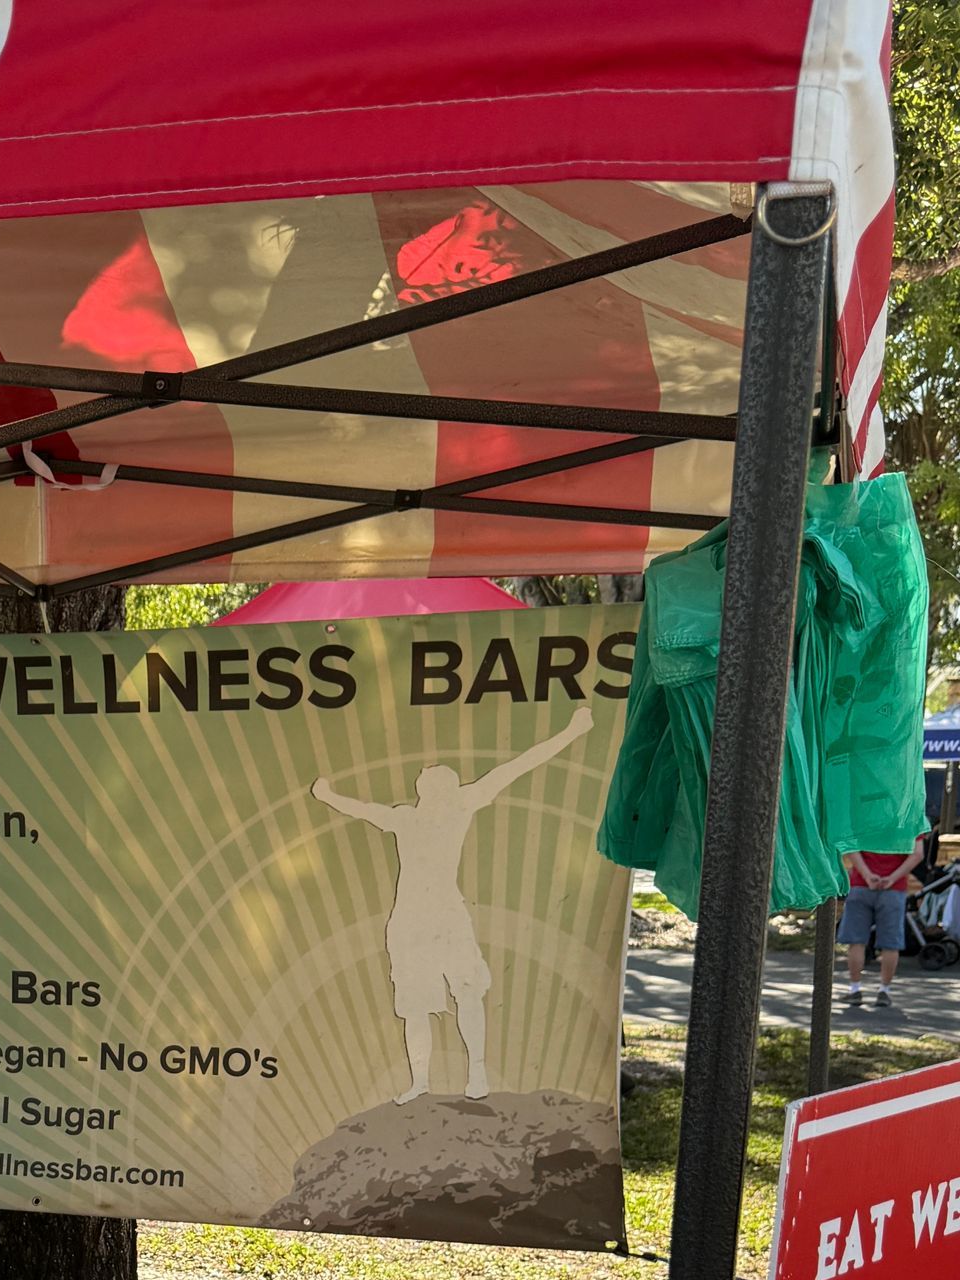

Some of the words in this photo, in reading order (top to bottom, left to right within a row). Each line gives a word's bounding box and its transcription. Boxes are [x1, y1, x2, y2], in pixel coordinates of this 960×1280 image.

[410, 631, 639, 706] BARS
[11, 970, 101, 1007] Bars
[100, 1042, 148, 1073] No
[159, 1044, 278, 1079] GMO's
[20, 1098, 120, 1136] Sugar
